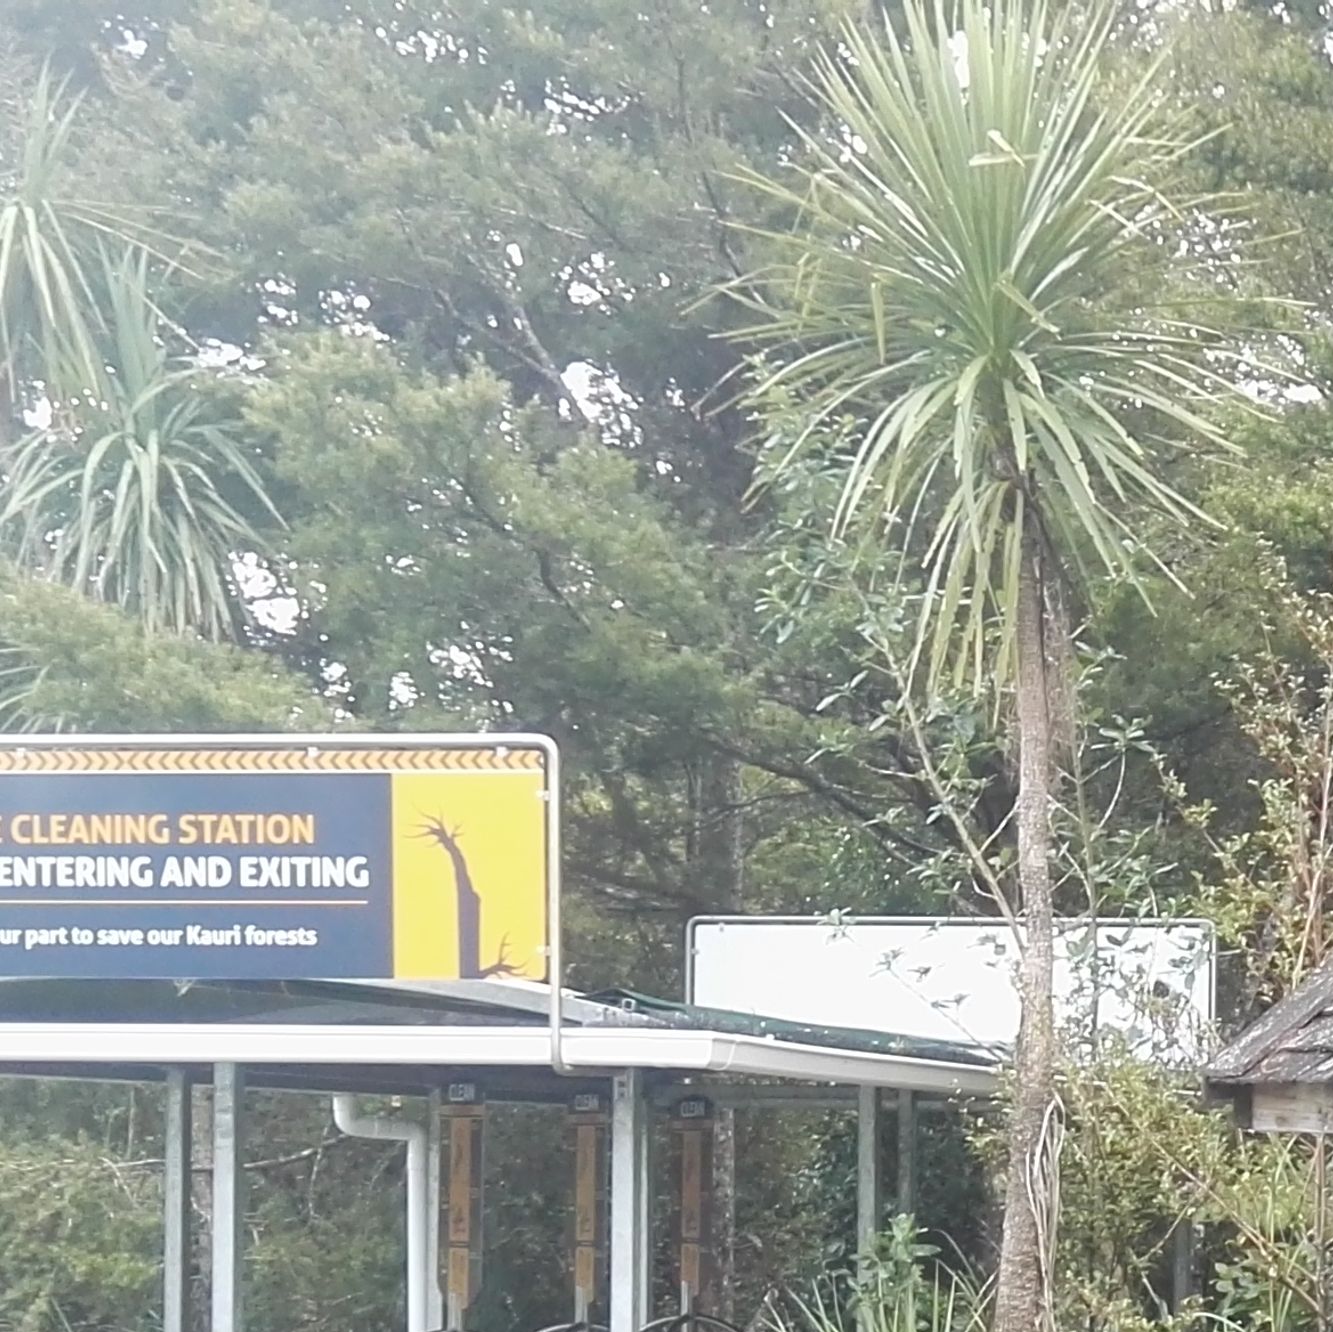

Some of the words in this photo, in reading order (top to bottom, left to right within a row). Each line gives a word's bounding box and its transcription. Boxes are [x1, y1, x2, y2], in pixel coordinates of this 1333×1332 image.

[11, 814, 169, 845] CLEANING
[179, 814, 314, 845] STATION
[0, 856, 153, 888] ENTERING
[161, 856, 232, 888] AND
[240, 856, 370, 888] EXITING
[25, 927, 69, 950] part
[71, 927, 93, 945] to
[97, 930, 144, 945] save
[147, 930, 183, 945] our
[187, 925, 241, 945] Kauri
[245, 926, 318, 946] forests
